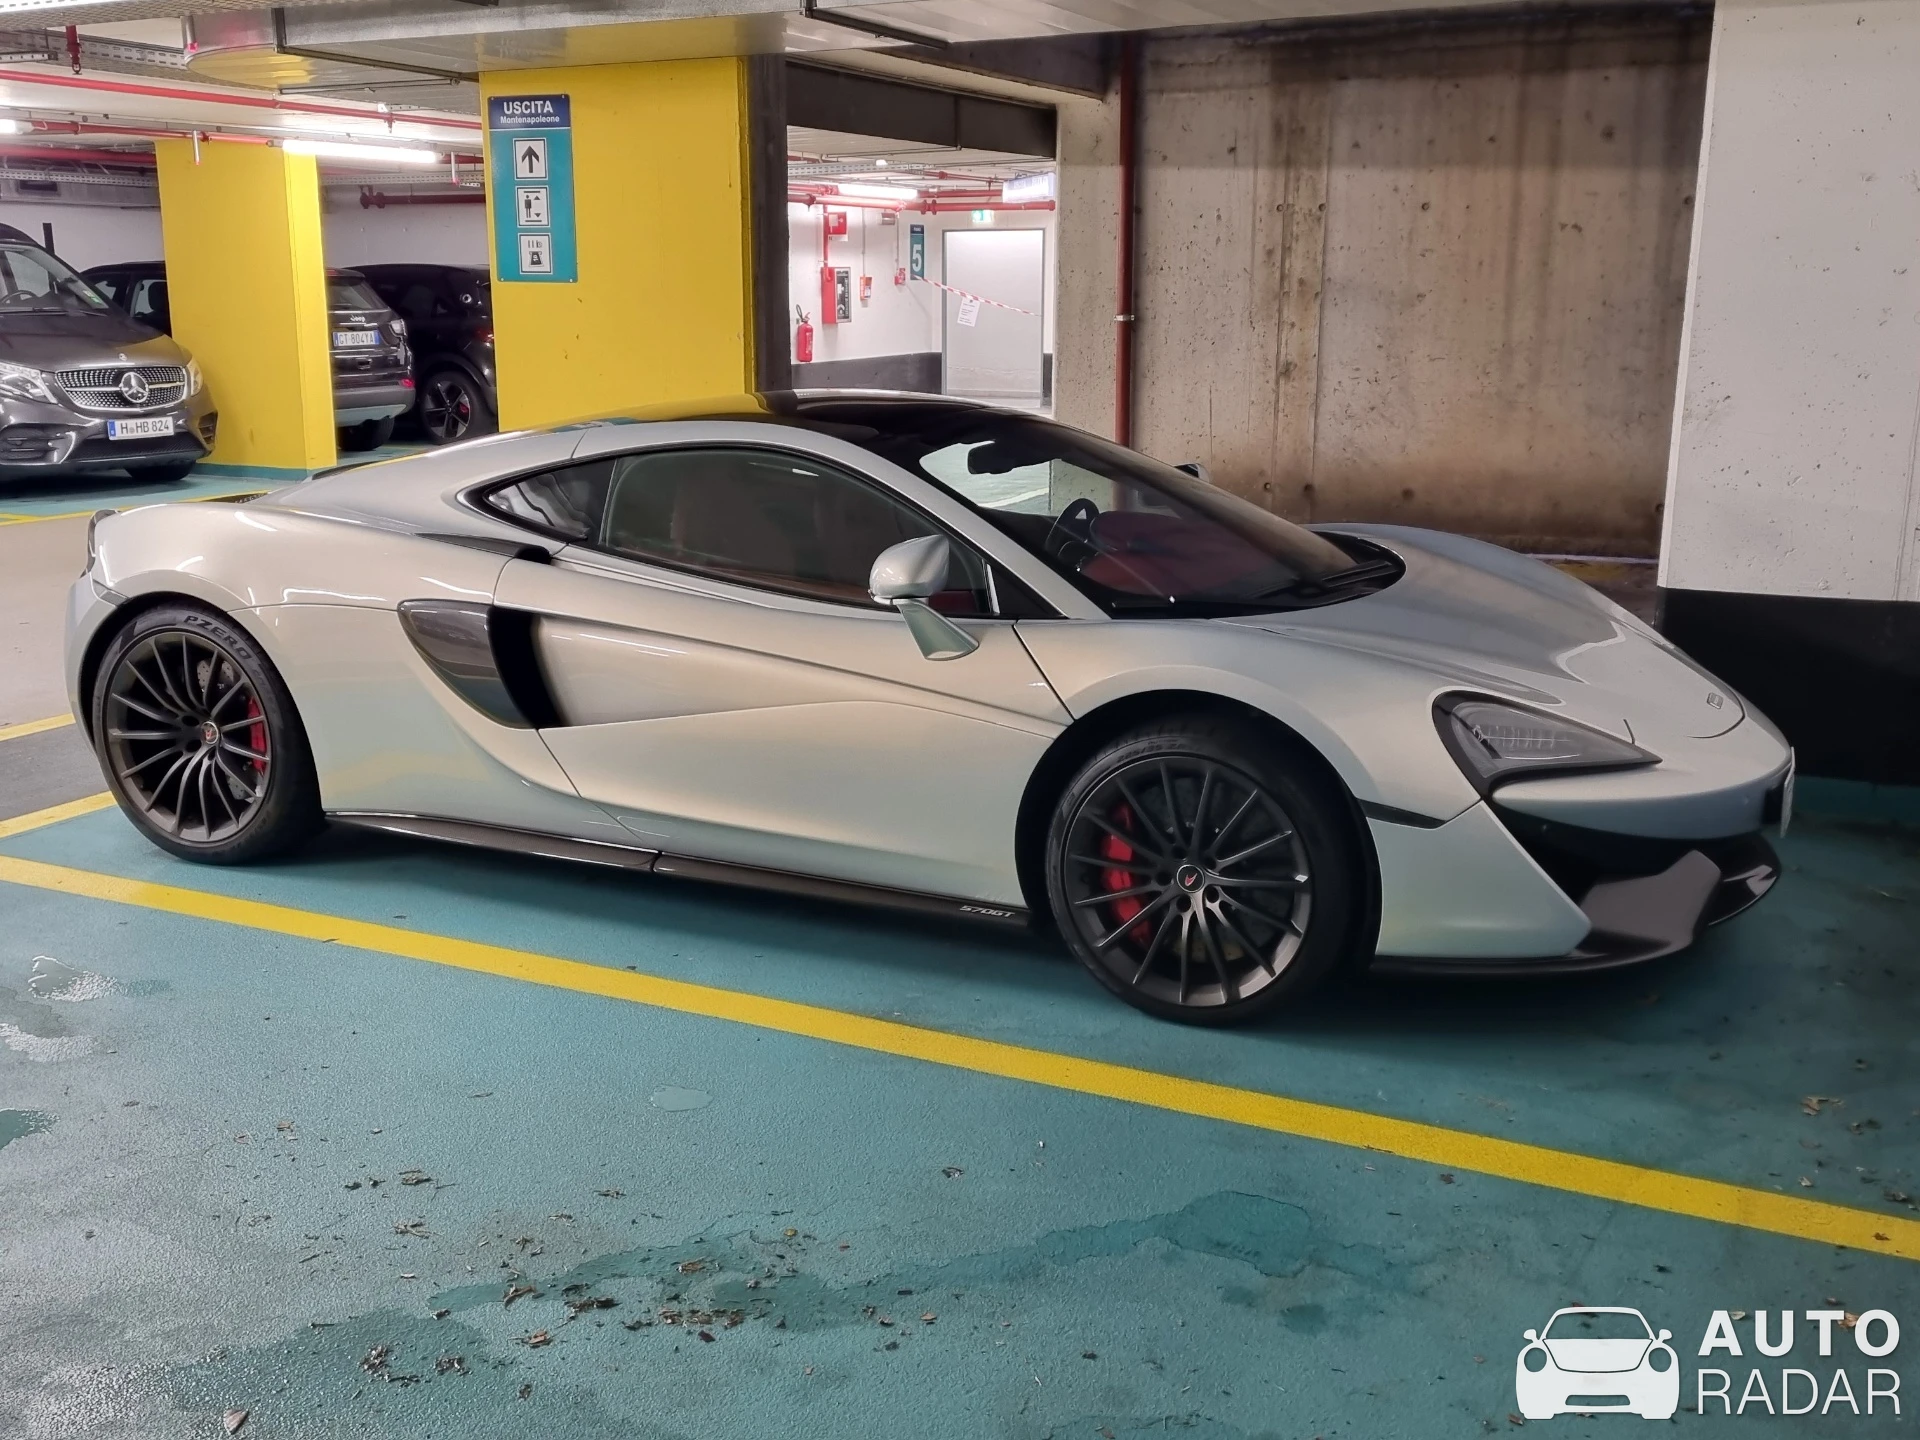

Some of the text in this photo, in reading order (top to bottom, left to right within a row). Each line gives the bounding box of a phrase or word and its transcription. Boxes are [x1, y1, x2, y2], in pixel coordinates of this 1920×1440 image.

[503, 100, 553, 115] USCITA
[500, 115, 560, 125] Montenapoleone
[912, 244, 922, 272] 5
[120, 420, 169, 434] H HB 824
[959, 905, 1016, 918] 570GT
